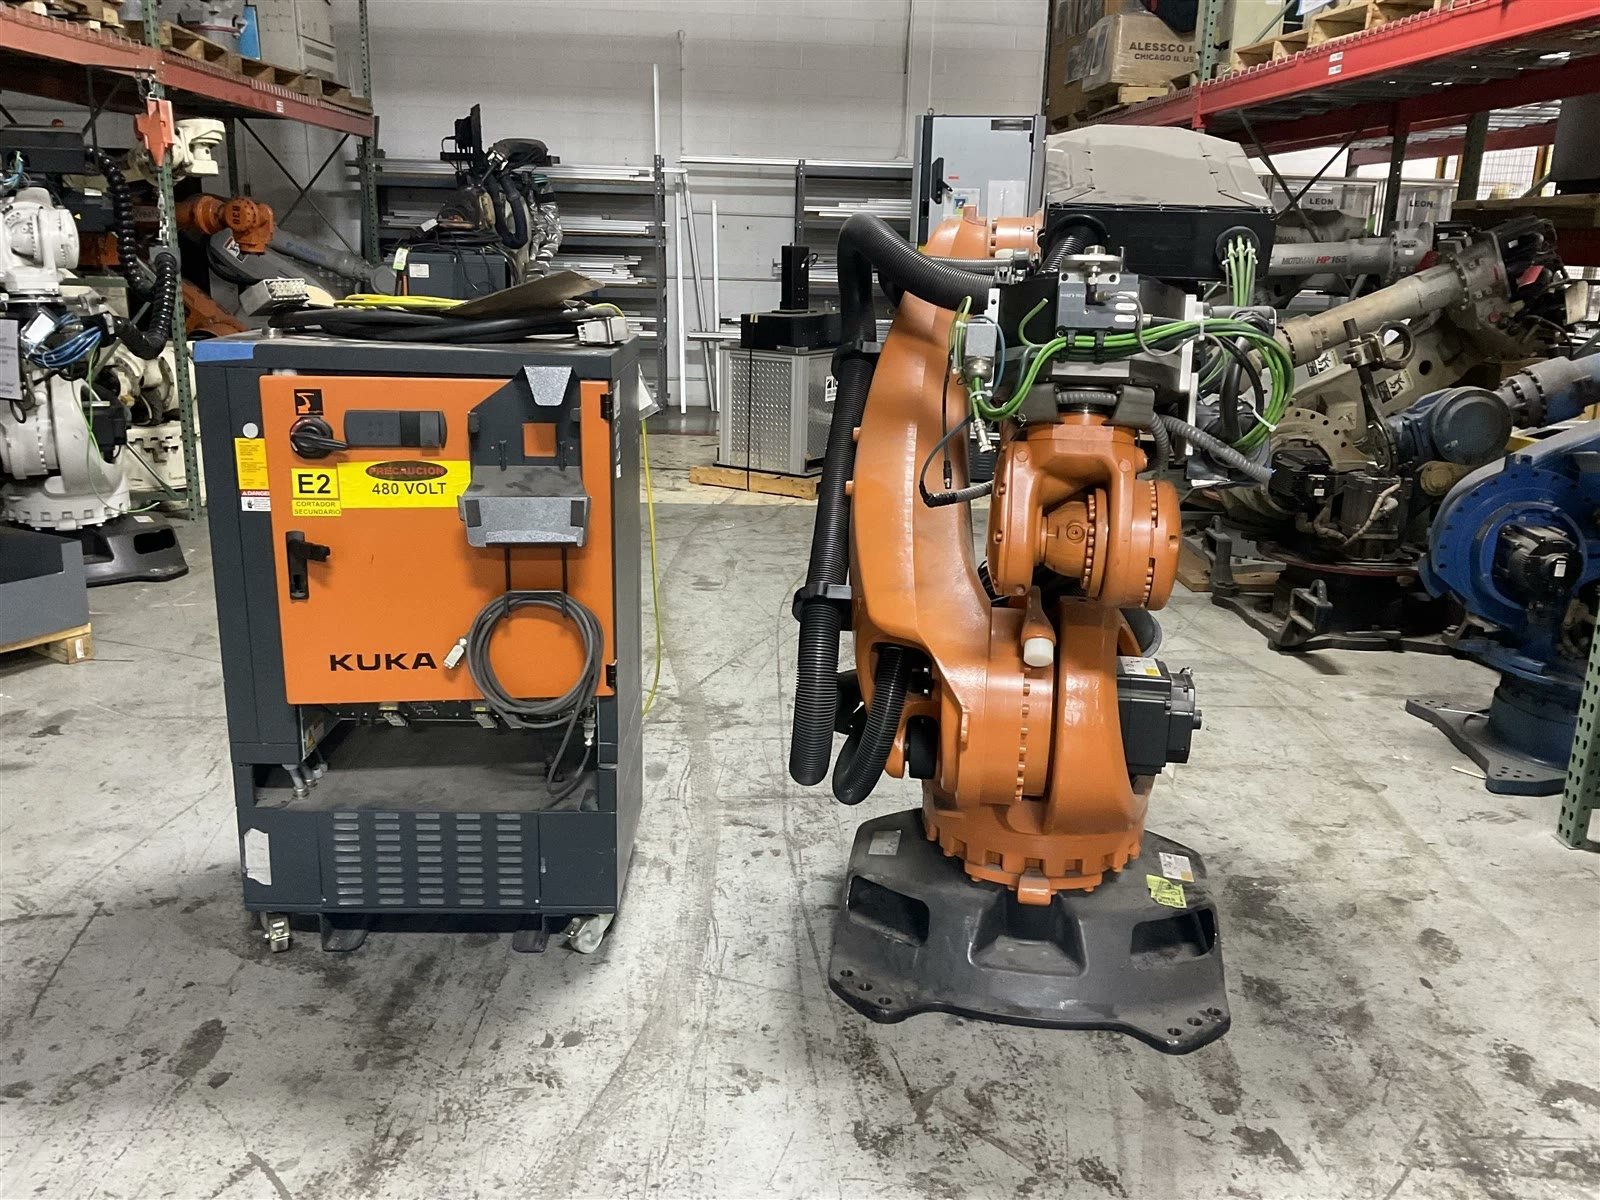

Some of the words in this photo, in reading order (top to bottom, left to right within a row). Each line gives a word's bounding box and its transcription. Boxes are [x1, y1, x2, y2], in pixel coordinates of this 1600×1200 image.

[1129, 42, 1185, 53] ALESSCO
[1134, 53, 1172, 62] CHICAGO
[368, 466, 445, 476] PRECAUCION
[297, 473, 332, 494] E2
[371, 483, 400, 495] 480
[403, 482, 447, 495] VOLT
[329, 652, 438, 671] KUKA
